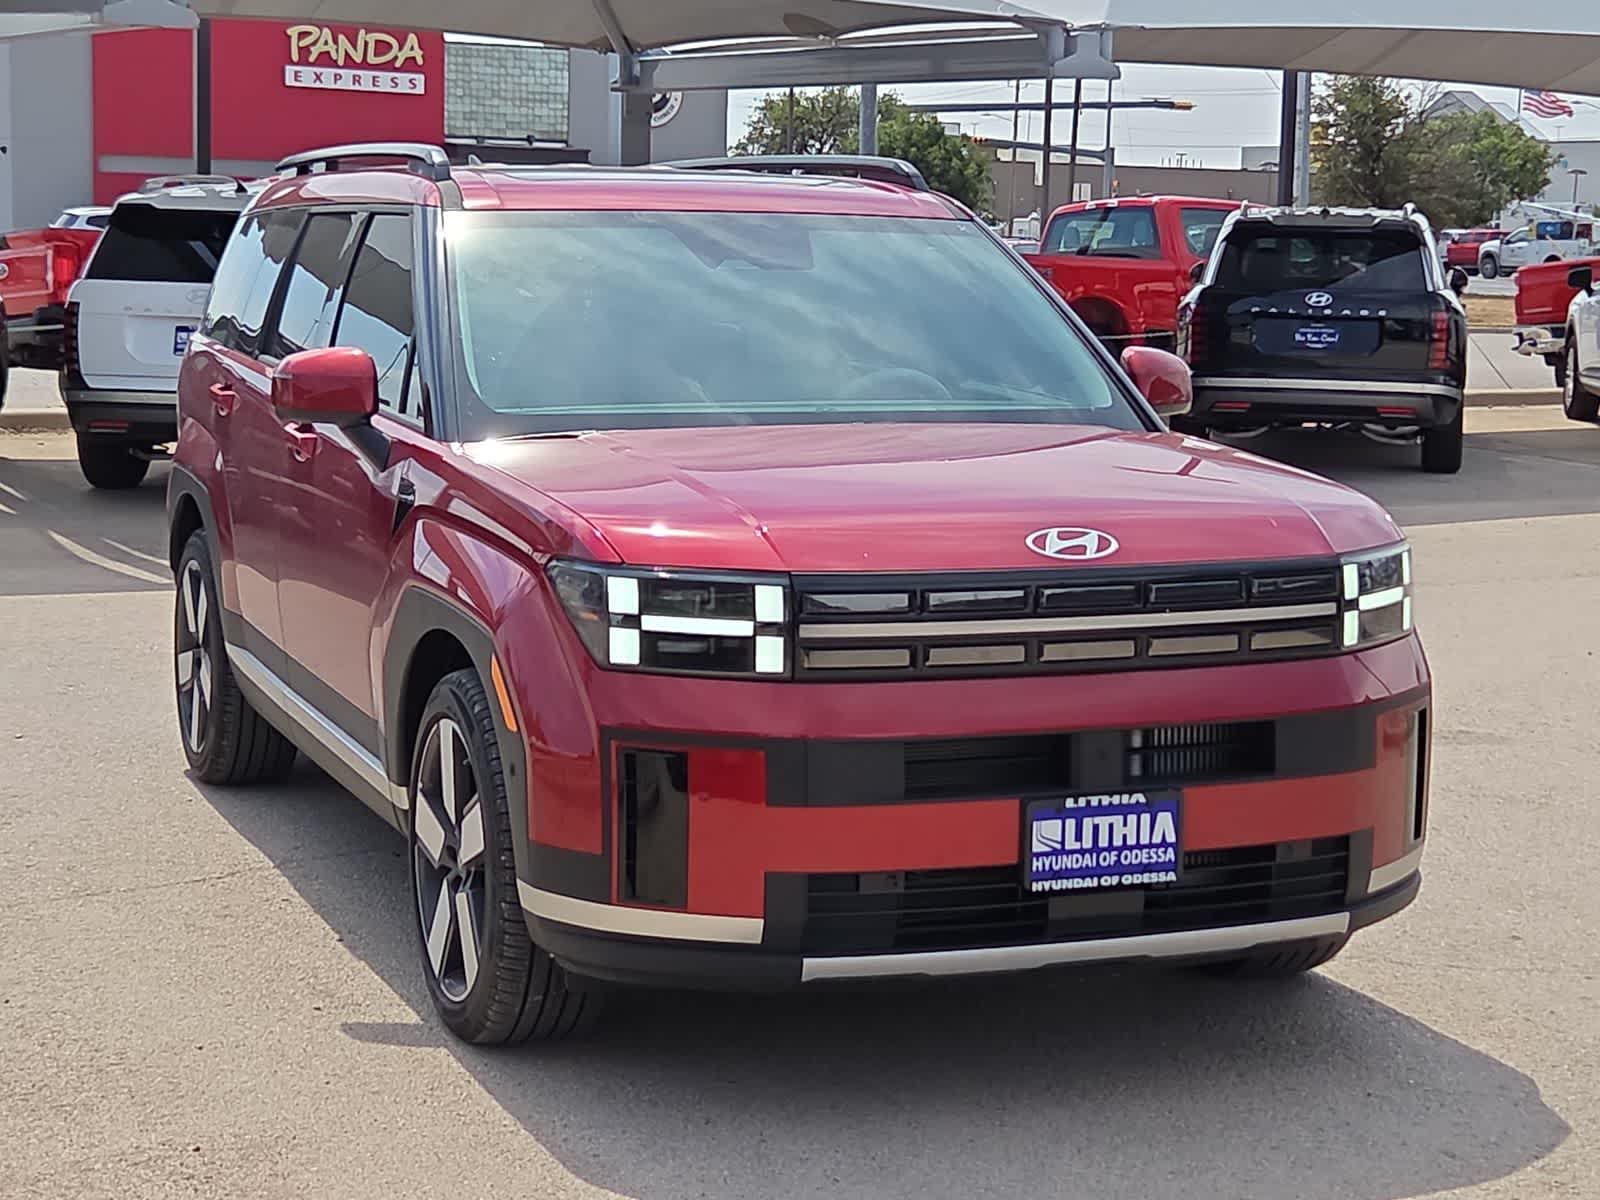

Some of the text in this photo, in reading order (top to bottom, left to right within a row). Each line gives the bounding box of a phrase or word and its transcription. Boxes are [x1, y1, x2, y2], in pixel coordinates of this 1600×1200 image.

[286, 25, 424, 68] PANDA
[293, 70, 418, 90] EXPRESS
[1065, 793, 1147, 808] LITHIA
[1064, 811, 1176, 850] LITHIA
[1032, 847, 1175, 872] HYUNDAI OF ODESSA
[1031, 871, 1177, 892] HYUNDAI OF ODESSA
